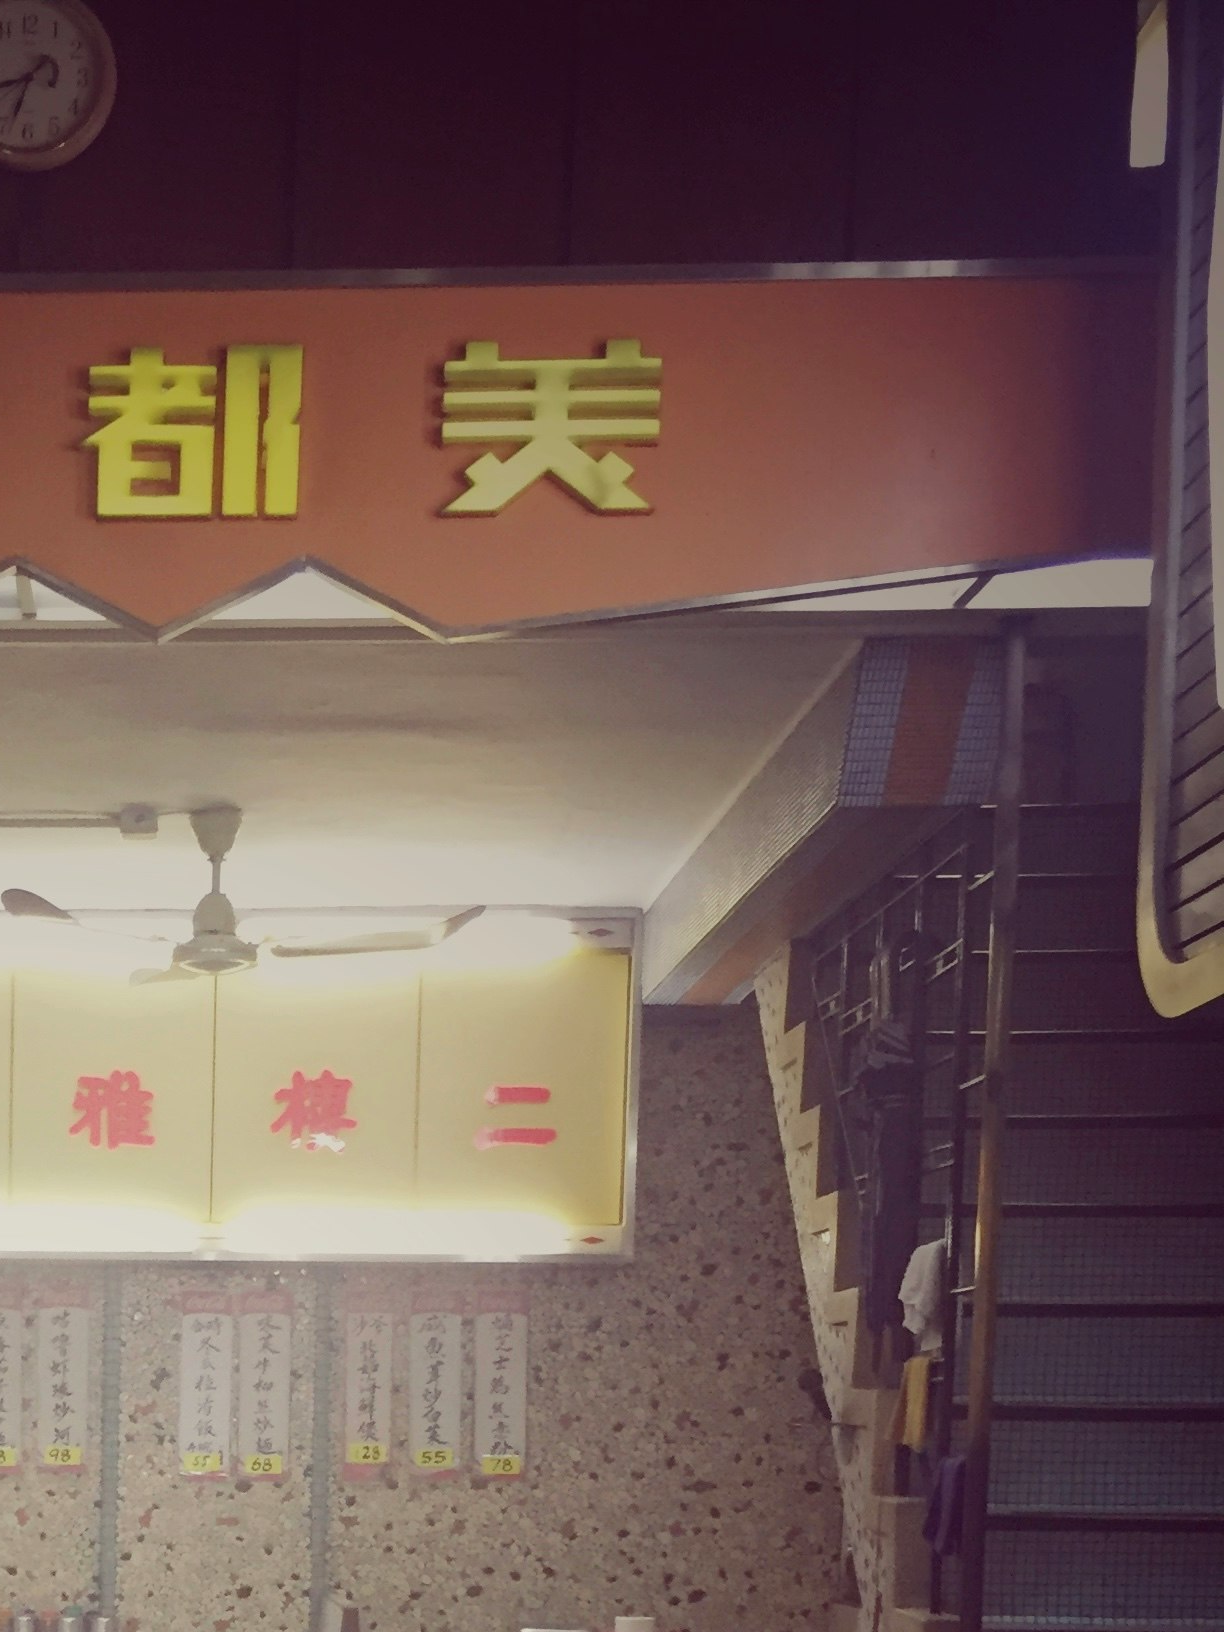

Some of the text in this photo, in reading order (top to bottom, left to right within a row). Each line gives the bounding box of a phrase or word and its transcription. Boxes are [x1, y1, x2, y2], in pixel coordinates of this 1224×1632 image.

[48, 1447, 72, 1463] 98
[192, 1454, 211, 1467] 55
[421, 1450, 447, 1464] 55
[251, 1456, 274, 1473] 68
[490, 1458, 514, 1473] 78
